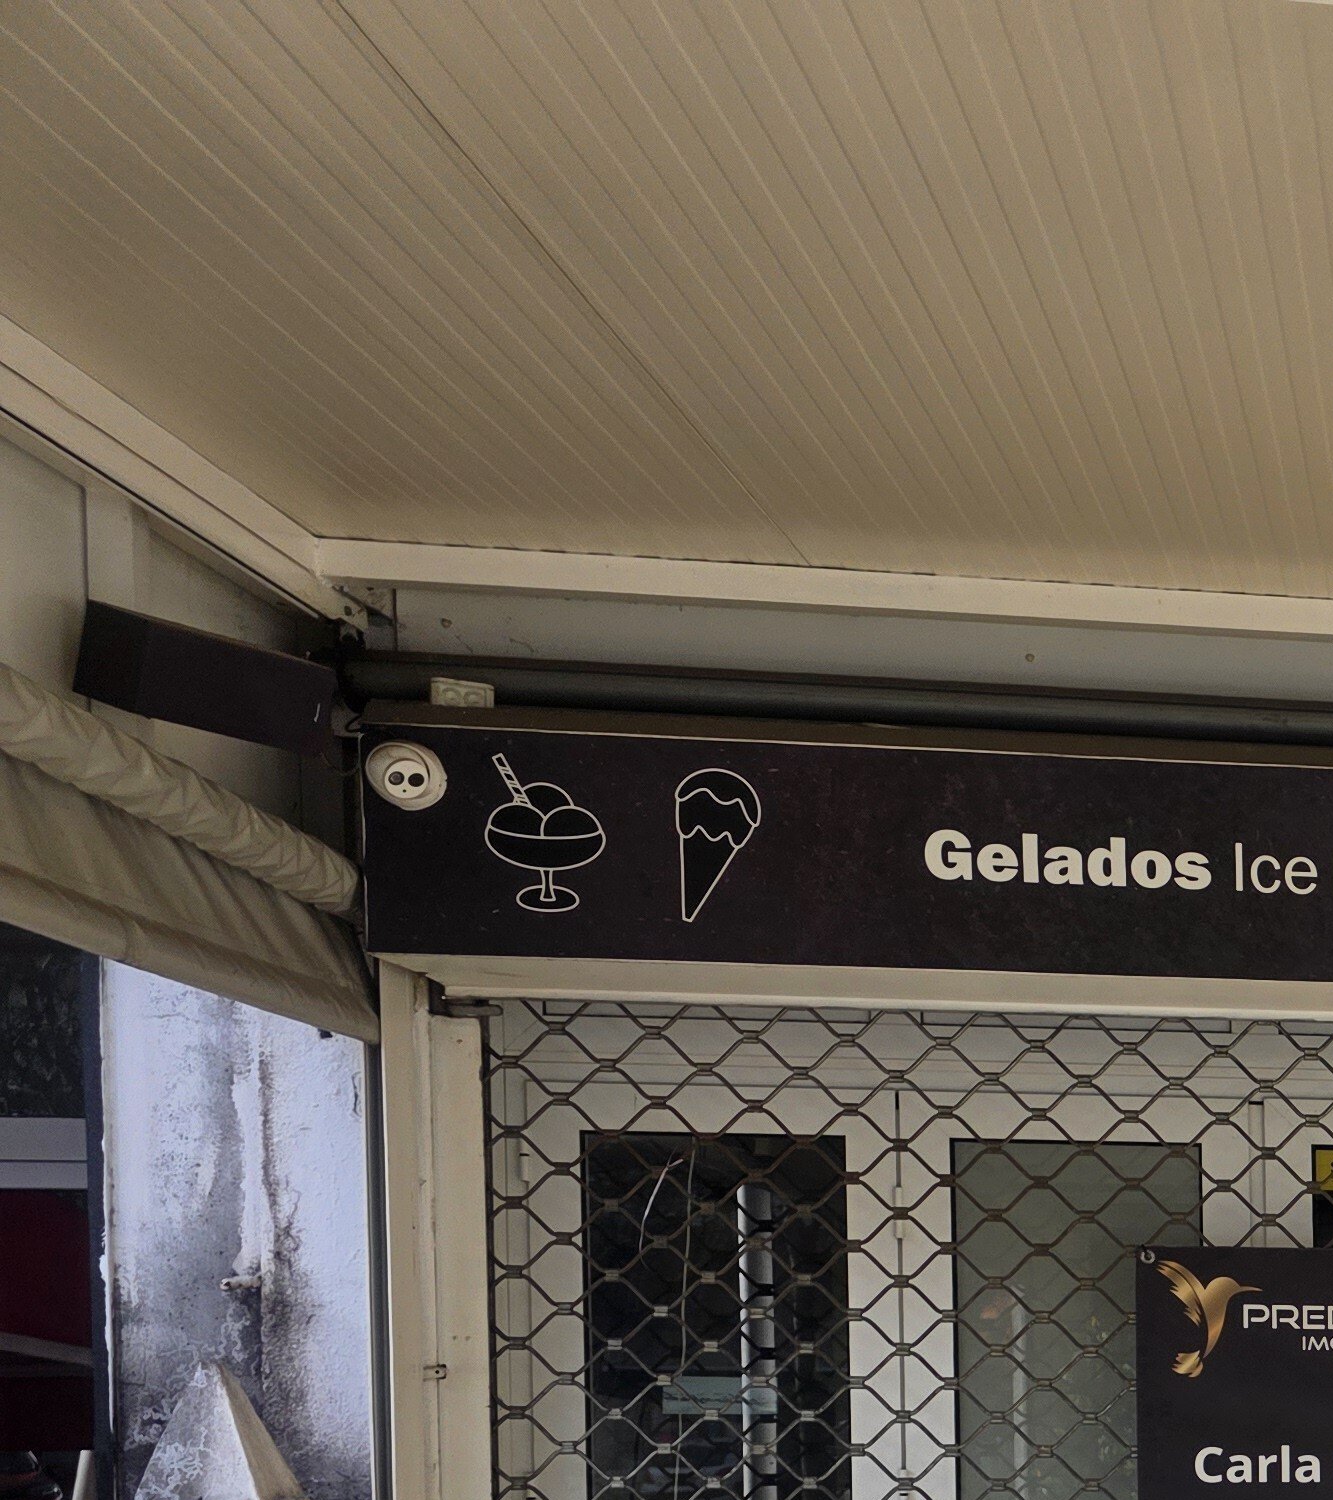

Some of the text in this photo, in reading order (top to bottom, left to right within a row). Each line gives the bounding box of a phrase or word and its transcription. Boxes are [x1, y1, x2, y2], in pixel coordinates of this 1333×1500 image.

[924, 828, 1213, 891] Gelados
[1234, 840, 1319, 898] Ice
[1194, 1445, 1322, 1484] Carla
